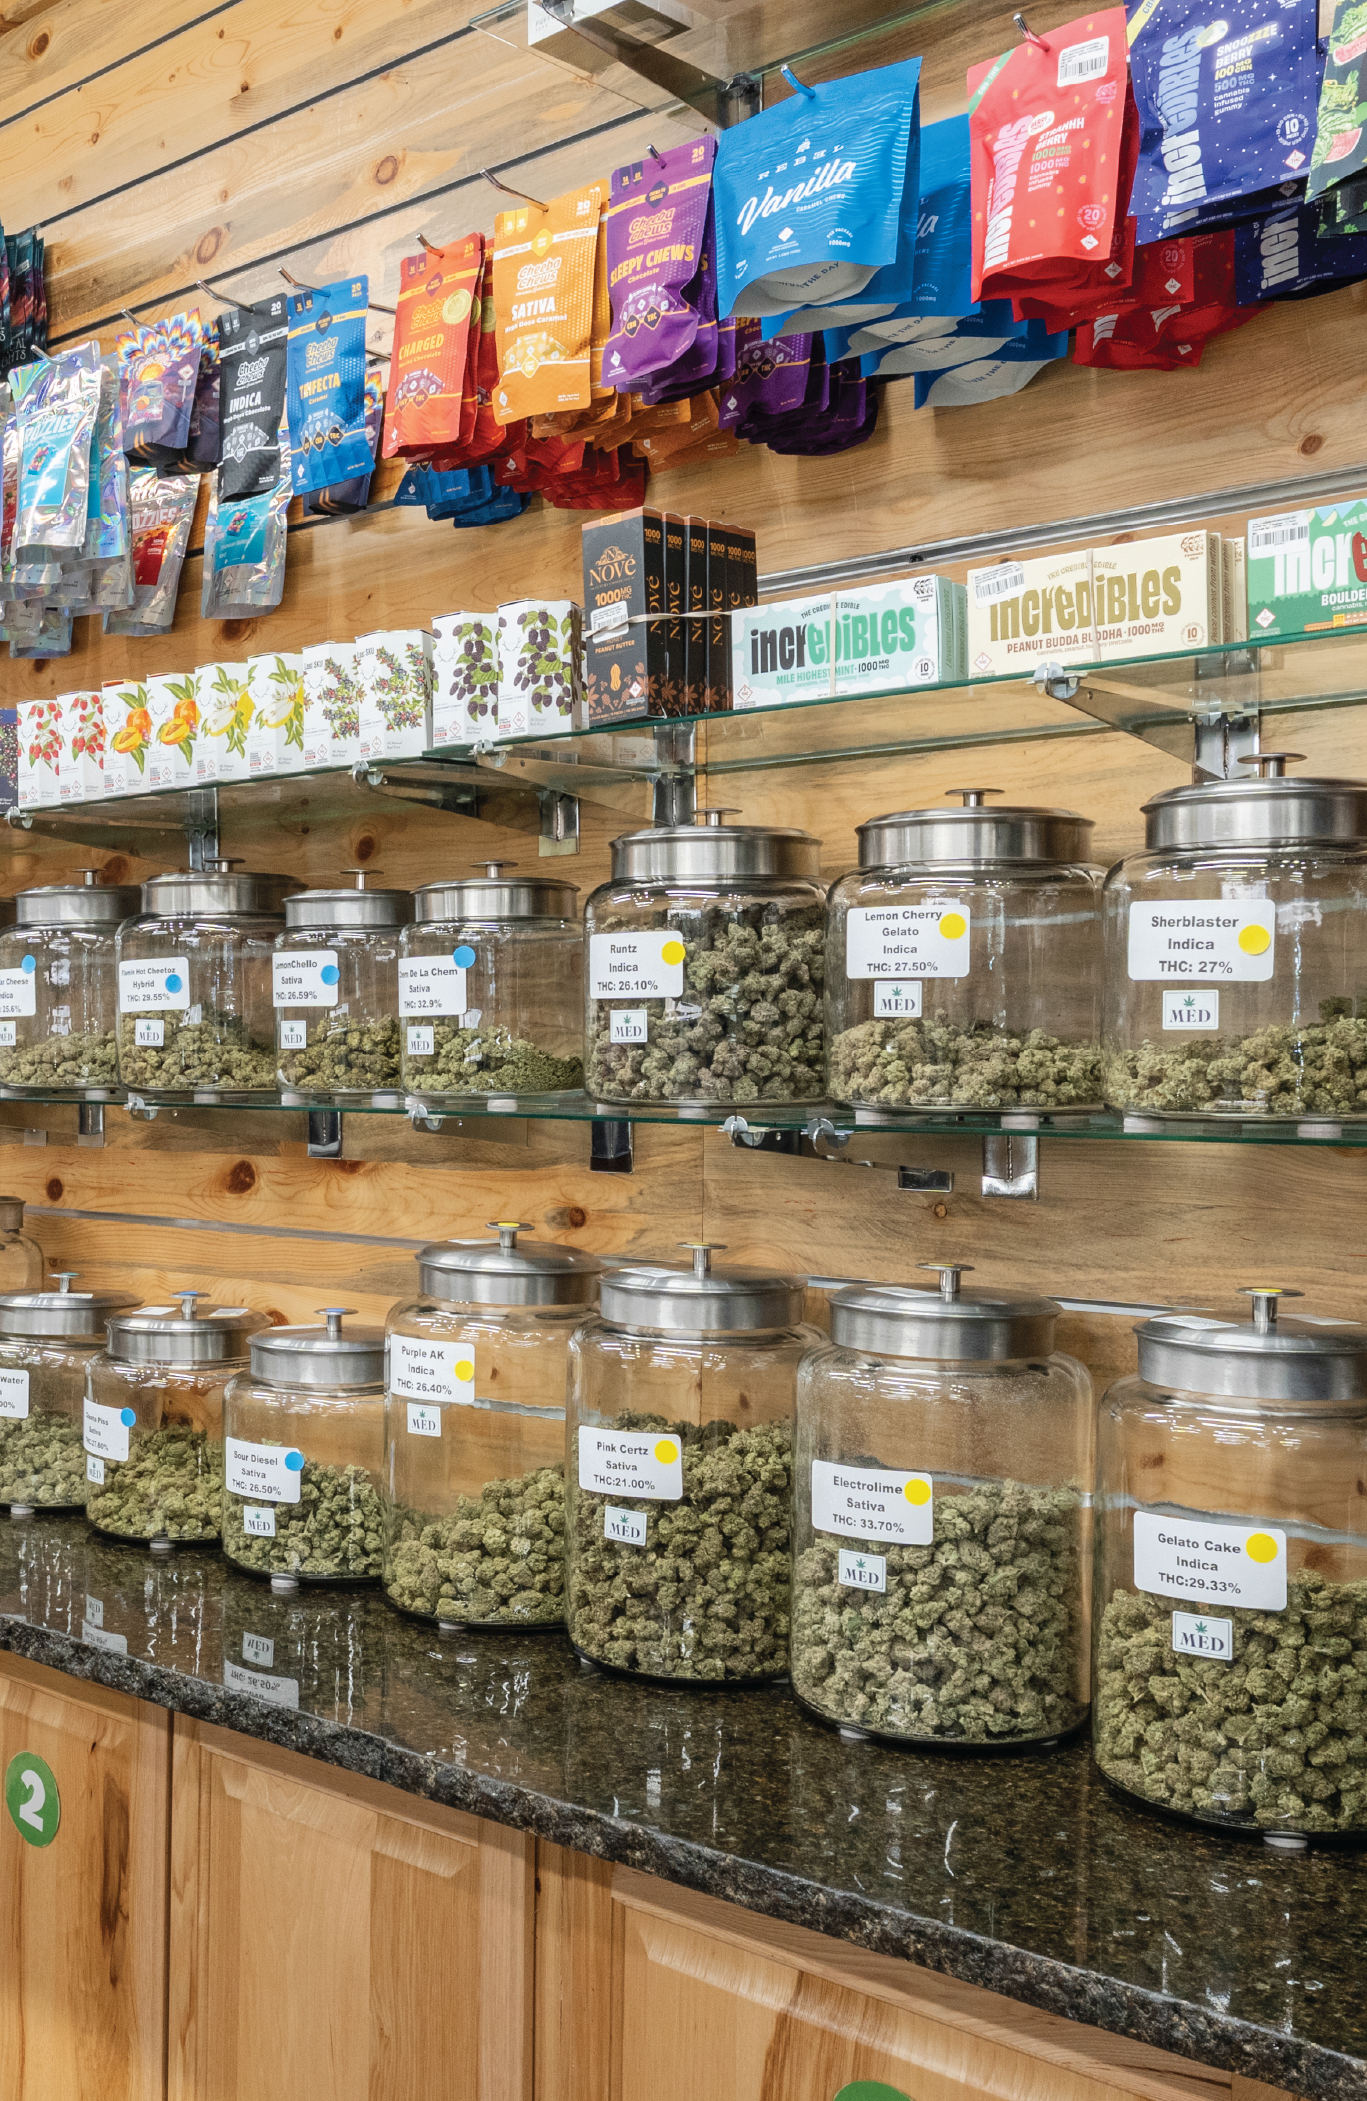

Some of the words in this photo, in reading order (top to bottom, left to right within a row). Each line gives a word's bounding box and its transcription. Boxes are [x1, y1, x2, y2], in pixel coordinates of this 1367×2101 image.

[1216, 23, 1278, 56] SNOOZZZE
[1215, 45, 1254, 69] BERRY
[1214, 65, 1235, 81] 100
[1236, 58, 1252, 66] MG
[1214, 77, 1237, 92] 500
[1214, 87, 1250, 101] cannabis
[1214, 95, 1244, 108] infused
[1214, 102, 1242, 116] gummy
[1285, 119, 1299, 134] 10
[1035, 133, 1068, 151] BERRY
[692, 145, 704, 158] 20
[1032, 145, 1056, 162] 1000
[1030, 158, 1055, 174] 1000
[1028, 170, 1059, 181] cannabis
[1028, 175, 1054, 187] infused
[736, 158, 856, 236] Vanilla
[576, 200, 590, 211] 20
[629, 208, 676, 234] Cheeba
[1084, 209, 1099, 221] 20
[628, 222, 672, 244] Chews
[465, 242, 474, 252] 20
[828, 239, 851, 247] 1000mg
[1166, 250, 1178, 262] 20
[519, 257, 562, 280] Cheeba
[610, 252, 644, 288] SLEEPY
[646, 244, 695, 267] CHEWS
[821, 260, 840, 275] DAY
[517, 269, 558, 290] Chews
[628, 267, 659, 284] Chocolate
[352, 283, 361, 293] 20
[271, 301, 281, 311] 20
[511, 296, 556, 321] SATIVA
[536, 313, 568, 325] Caramel
[306, 337, 338, 358] Cheeba
[398, 333, 444, 361] CHARGED
[306, 350, 335, 368] Chews
[414, 351, 442, 364] Chocolate
[238, 357, 269, 377] Cheeba
[300, 373, 341, 399] TRIFECTA
[229, 391, 261, 414] INDICA
[1343, 516, 1359, 527] THE
[644, 529, 661, 539] 1000
[667, 535, 682, 545] 1000
[690, 538, 704, 549] 1000
[710, 542, 725, 553] 1000
[727, 546, 741, 556] 1000
[1093, 561, 1117, 570] EDIBLE
[595, 588, 621, 606] 1000
[620, 586, 632, 595] MG
[620, 592, 632, 601] THC
[800, 610, 812, 619] THE
[841, 602, 860, 610] EDIBLE
[1007, 639, 1043, 653] PEANUT
[1045, 634, 1079, 648] BUDDA
[1128, 624, 1151, 637] 1000
[1188, 627, 1197, 638] 10
[365, 647, 374, 656] SKU
[595, 643, 615, 654] PEANUT
[615, 639, 636, 650] BUTTER
[314, 660, 324, 669] SKU
[920, 662, 929, 673] 10
[776, 673, 795, 685] MILE
[797, 667, 830, 682] HIGHEST
[835, 664, 855, 676] MINT
[858, 661, 878, 673] 1000
[865, 912, 899, 922] Lemon
[902, 911, 942, 921] Cherry
[1151, 915, 1239, 928] Sherblaster
[882, 927, 919, 937] Gelato
[610, 944, 637, 954] Runtz
[883, 945, 918, 954] Indica
[1168, 938, 1215, 950] Indica
[410, 970, 418, 978] De
[420, 969, 429, 977] La
[431, 968, 458, 976] Chem
[609, 962, 639, 973] Indica
[867, 962, 892, 972] THC:
[894, 961, 938, 971] 27.50%
[1159, 960, 1193, 973] THC:
[1198, 961, 1233, 974] 27%
[133, 980, 155, 990] Hybrid
[281, 976, 303, 985] Sativa
[598, 982, 616, 991] THC:
[619, 980, 658, 991] 26.10%
[288, 991, 318, 1000] 26.59%
[409, 985, 430, 993] Sativa
[142, 993, 170, 1002] 29.55%
[404, 1001, 416, 1009] THC:
[418, 999, 442, 1008] 32.9%
[3, 1005, 21, 1013] 25.6%
[880, 998, 916, 1011] MED
[1170, 1009, 1211, 1023] MED
[139, 1032, 160, 1041] MED
[615, 1025, 642, 1038] MED
[284, 1034, 302, 1044] MED
[410, 1041, 429, 1050] MED
[402, 1345, 427, 1359] Purple
[430, 1350, 445, 1360] AK
[408, 1363, 435, 1376] Indica
[397, 1378, 414, 1390] THC:
[416, 1382, 452, 1395] 26.40%
[97, 1417, 109, 1426] Piss
[412, 1418, 436, 1431] MED
[89, 1426, 101, 1436] Sativa
[597, 1441, 617, 1452] Pink
[619, 1444, 649, 1455] Certz
[234, 1450, 249, 1462] Sour
[251, 1454, 278, 1466] Diesel
[606, 1460, 638, 1471] Sativa
[89, 1468, 101, 1480] MED
[241, 1468, 266, 1479] Sativa
[232, 1479, 247, 1490] THC:
[250, 1483, 281, 1496] 26.50%
[593, 1474, 655, 1490] THC:21.00%
[833, 1475, 903, 1495] Electrolime
[847, 1497, 885, 1512] Sativa
[248, 1519, 270, 1531] MED
[832, 1513, 857, 1527] THC:
[860, 1518, 905, 1533] 33.70%
[610, 1522, 641, 1539] MED
[1158, 1533, 1199, 1549] Gelato
[1204, 1540, 1241, 1554] Cake
[1176, 1555, 1218, 1572] Indica
[844, 1567, 879, 1584] MED
[1158, 1572, 1242, 1594] THC:29.33%
[1180, 1631, 1225, 1652] MED
[19, 1769, 46, 1832] 2
